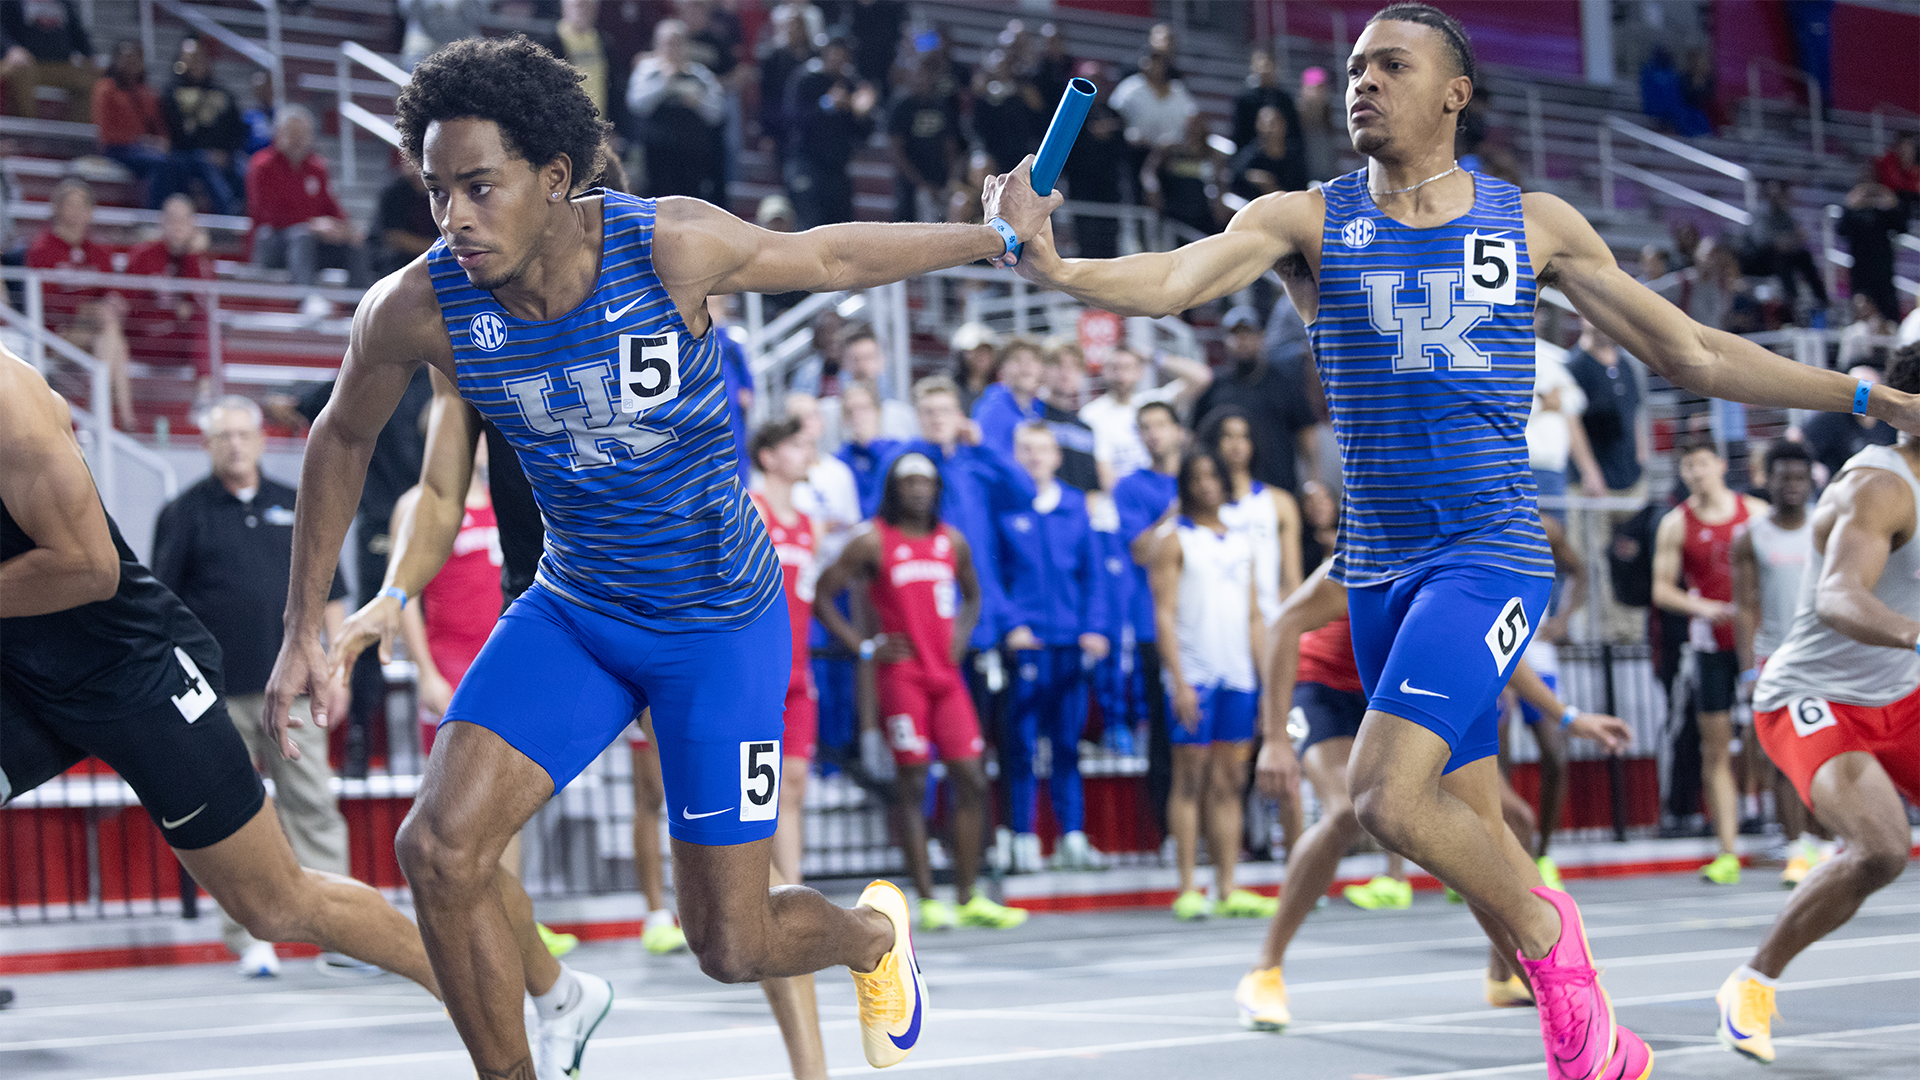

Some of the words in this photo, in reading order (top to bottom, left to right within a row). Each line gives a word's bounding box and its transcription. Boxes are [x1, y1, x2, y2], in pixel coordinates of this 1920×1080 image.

[1345, 218, 1373, 246] SEC
[1471, 238, 1509, 289] 5
[472, 315, 505, 349] SEC
[1361, 268, 1494, 374] UK
[628, 336, 672, 398] 5
[1498, 602, 1527, 656] 5
[1798, 697, 1824, 725] 6
[747, 743, 775, 806] 5
